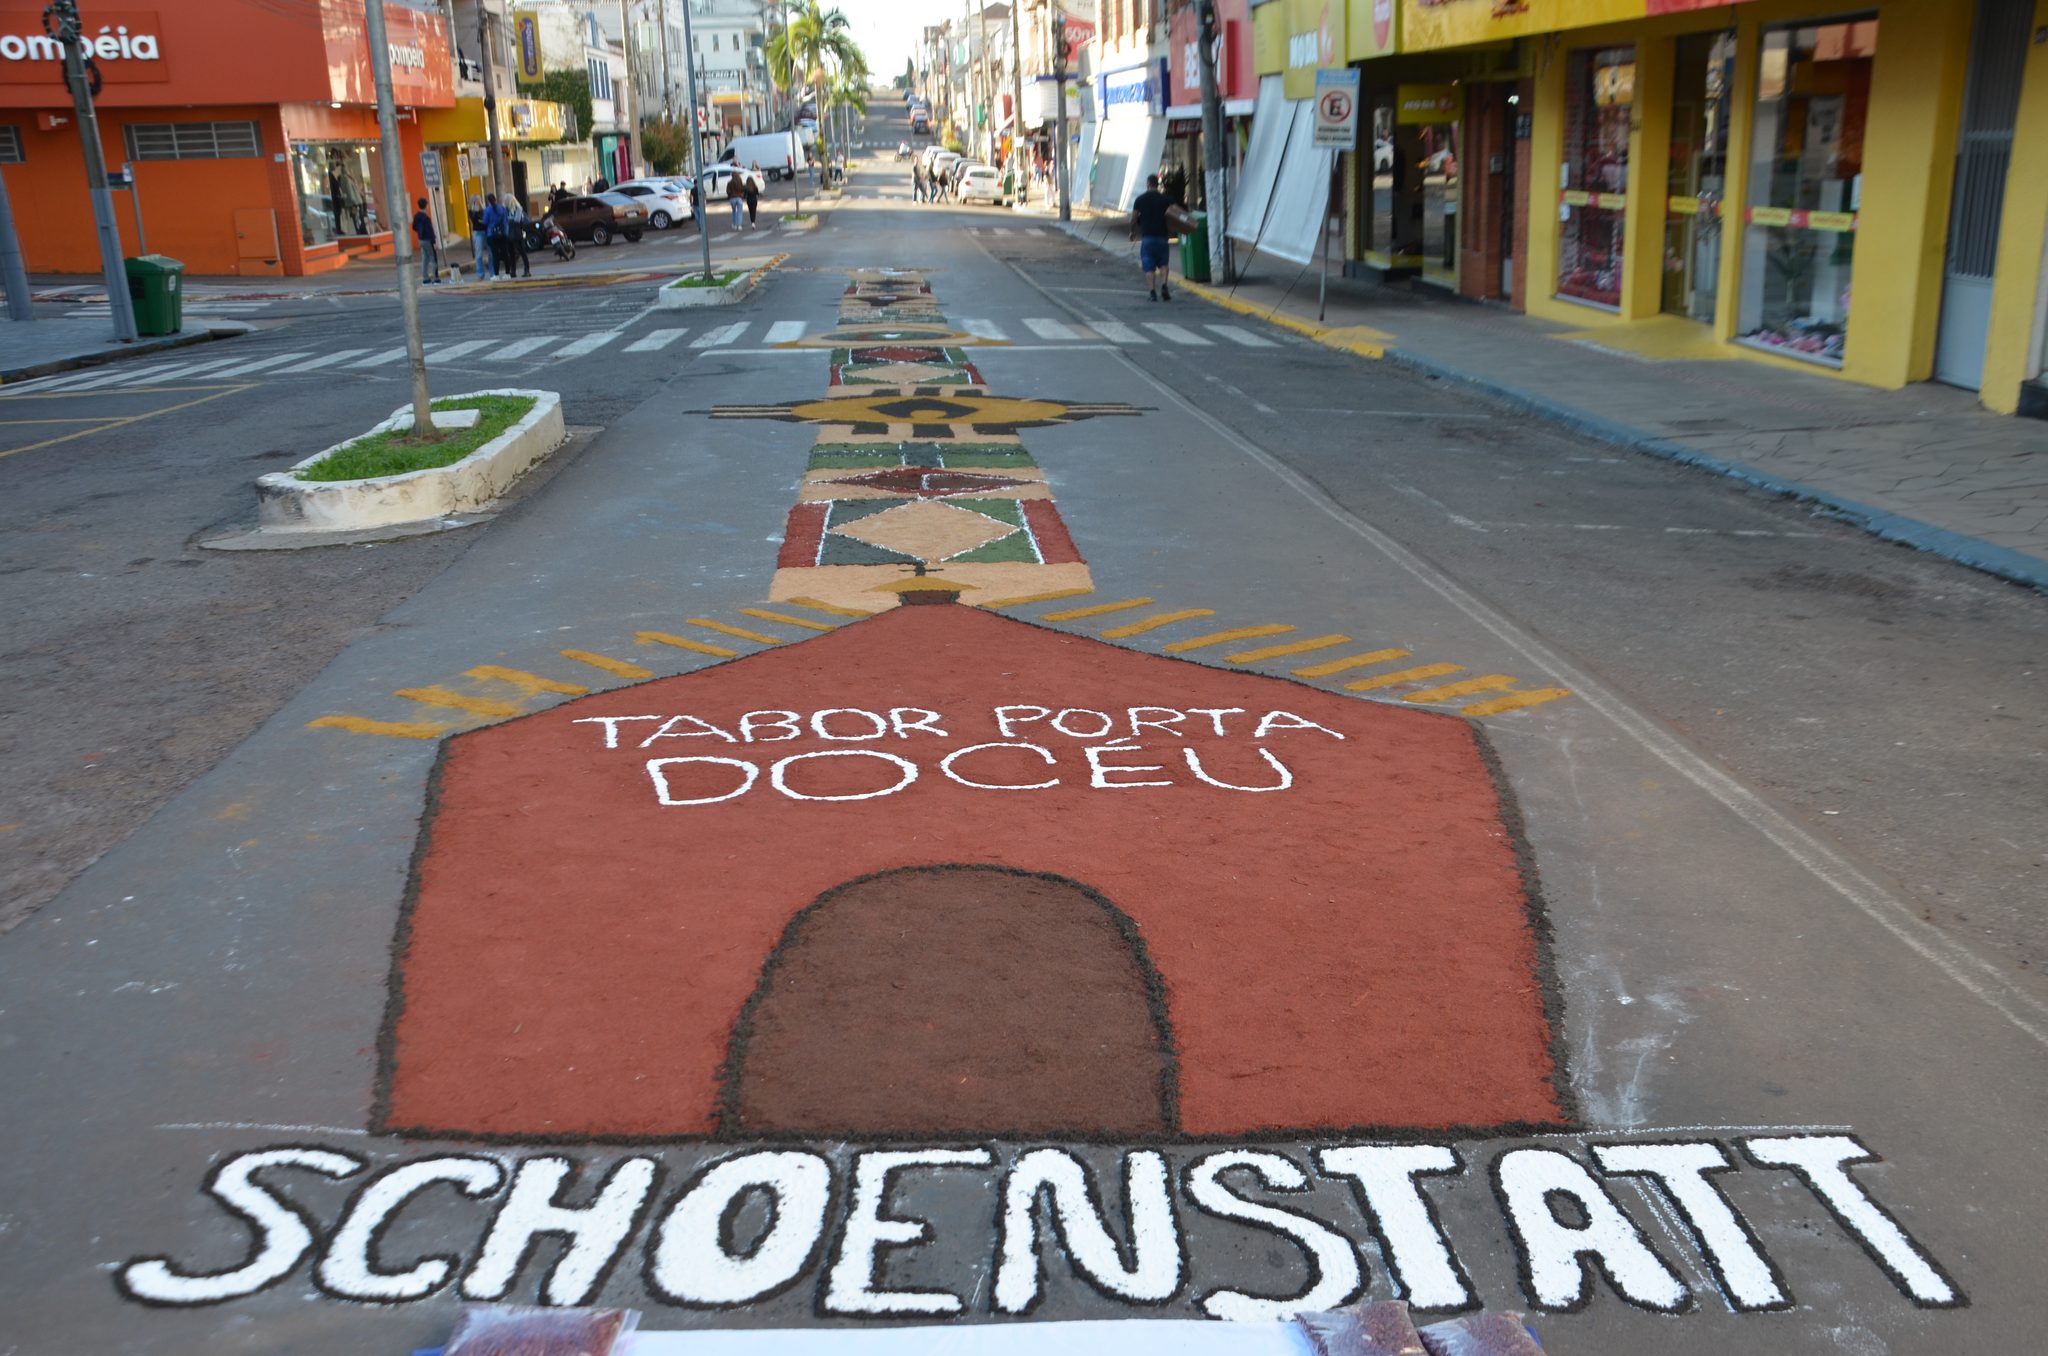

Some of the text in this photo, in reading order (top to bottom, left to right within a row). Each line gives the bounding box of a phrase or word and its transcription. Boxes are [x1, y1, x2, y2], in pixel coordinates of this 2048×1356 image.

[572, 704, 1346, 749] TABOR PORTA
[114, 1132, 1970, 1320] SCHOENSTATT
